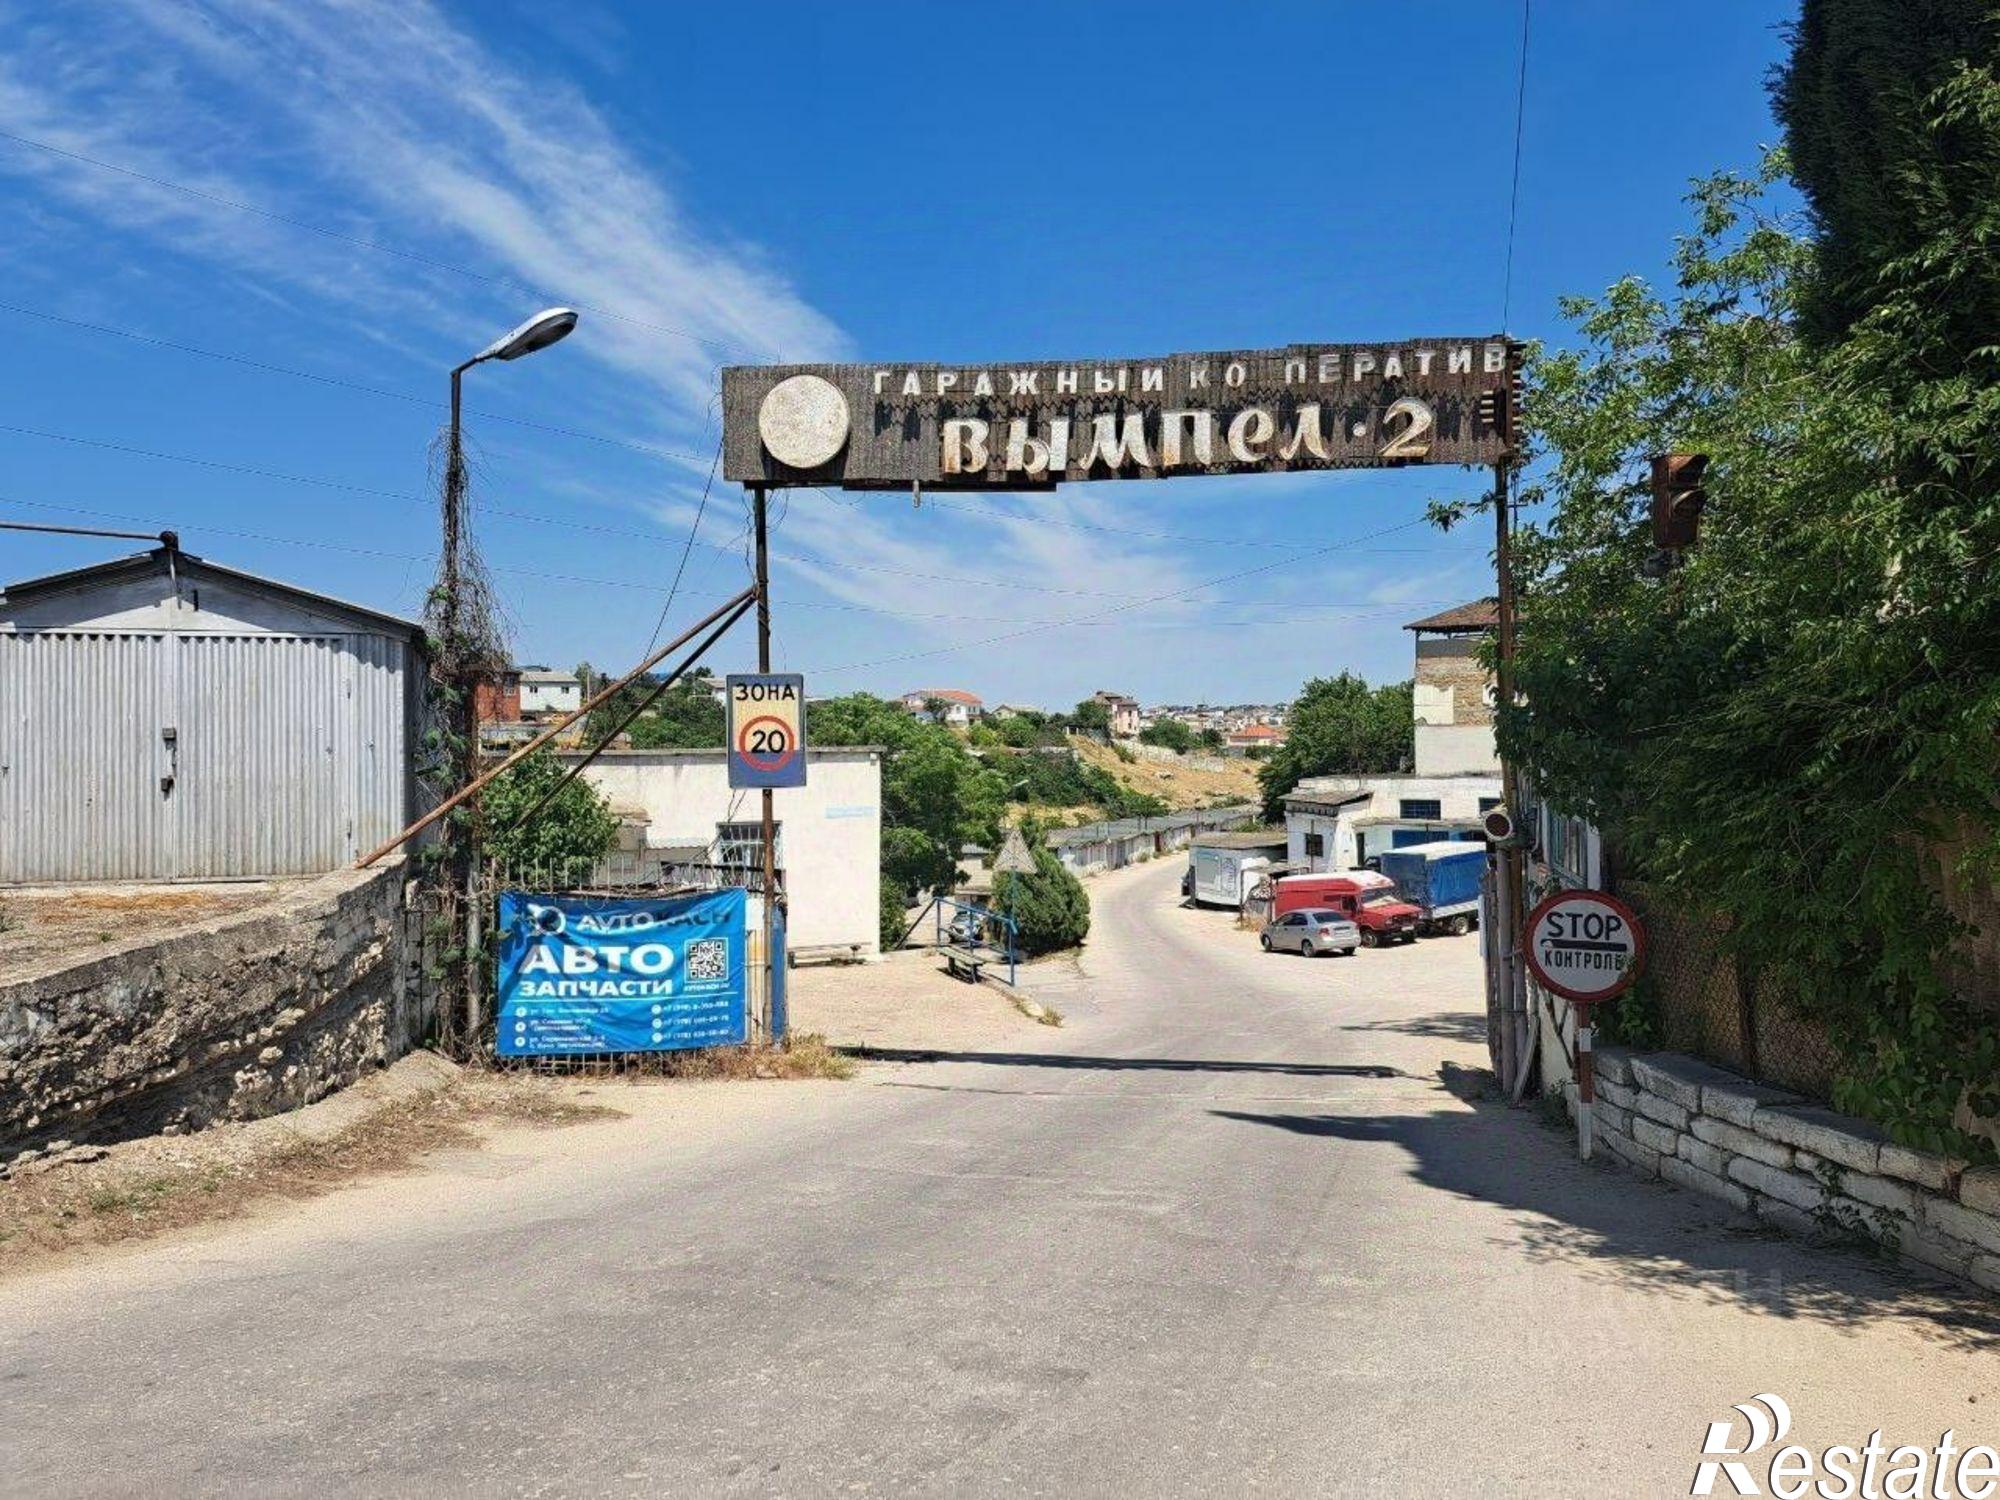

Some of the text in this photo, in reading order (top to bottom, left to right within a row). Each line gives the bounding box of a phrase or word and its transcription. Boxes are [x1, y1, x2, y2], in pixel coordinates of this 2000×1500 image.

[735, 683, 796, 701] ЗОНА
[751, 729, 786, 753] 20
[1546, 911, 1622, 940] STOP
[517, 943, 675, 975] АВТО
[518, 979, 674, 997] ЗАПЧАСТИ
